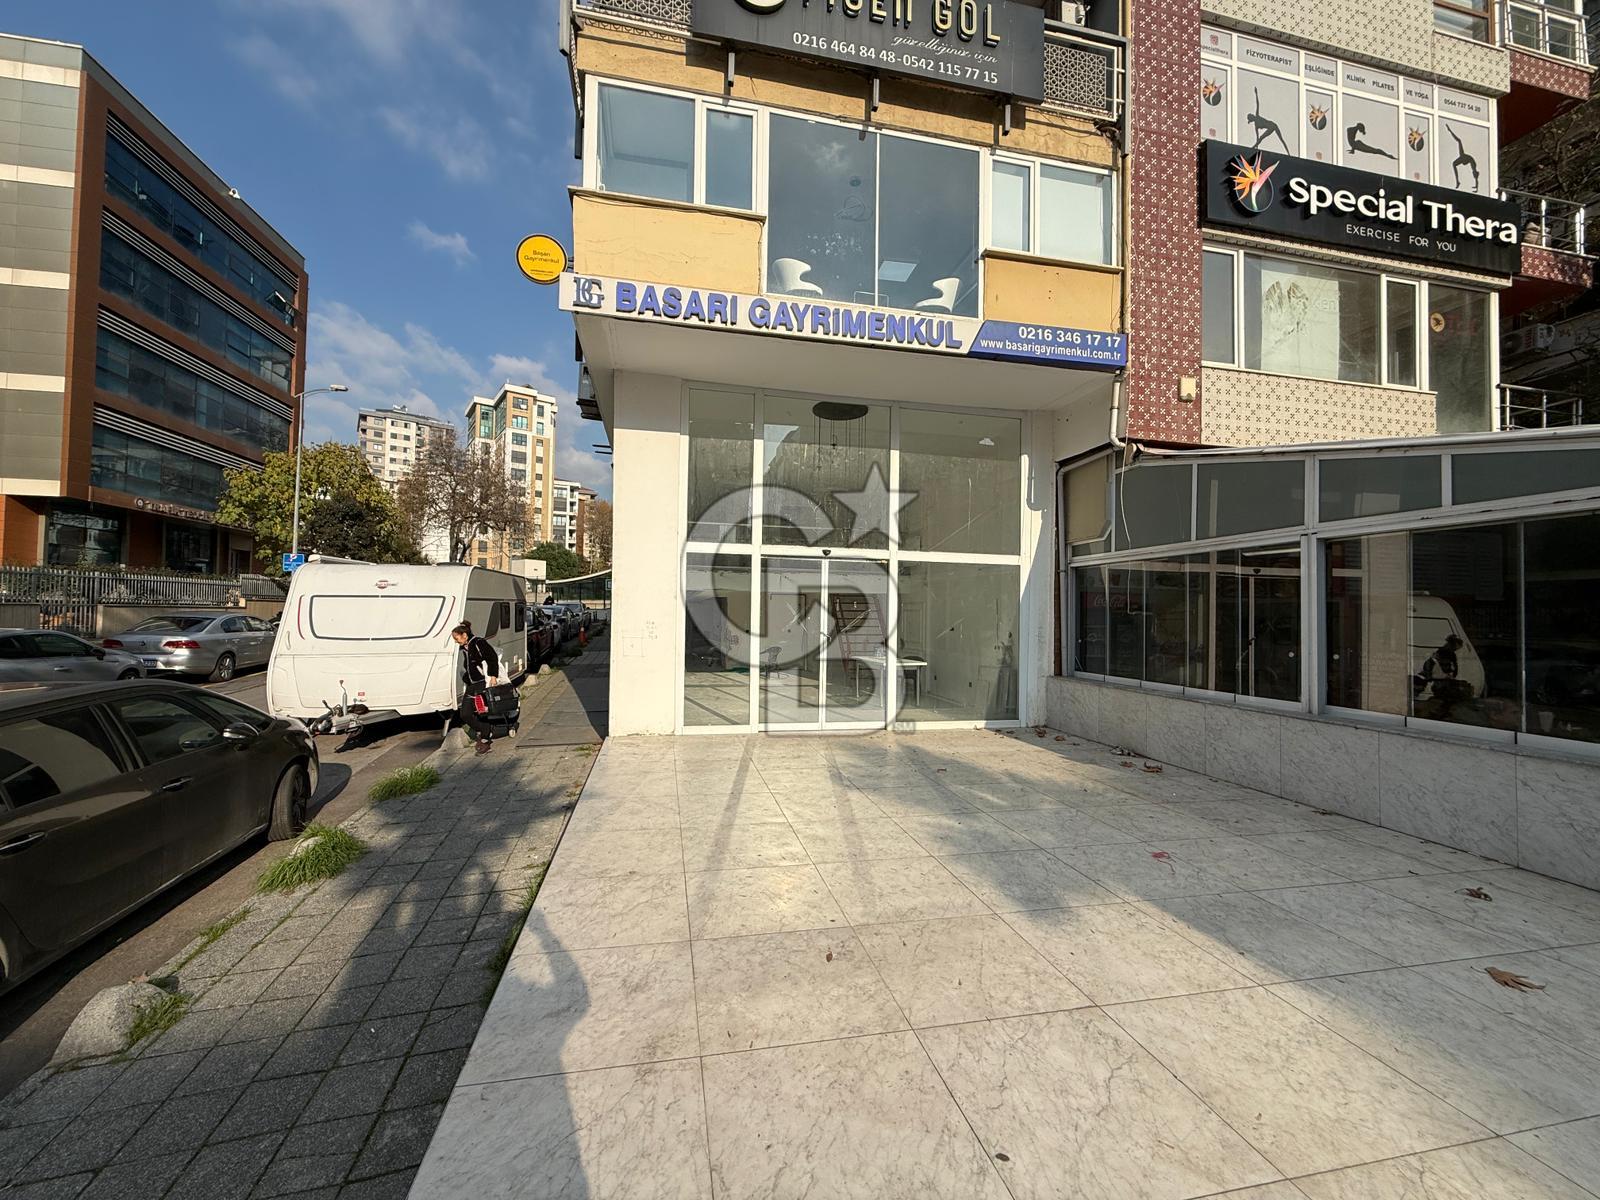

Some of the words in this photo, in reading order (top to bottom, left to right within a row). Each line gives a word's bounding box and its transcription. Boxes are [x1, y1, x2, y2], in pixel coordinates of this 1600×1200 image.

[793, 32, 828, 50] 0216
[830, 40, 856, 55] 464
[859, 45, 876, 60] 84
[879, 49, 935, 71] 48-0542
[938, 61, 961, 77] 115
[964, 66, 980, 80] 77
[983, 70, 998, 84] 15
[1414, 91, 1429, 100] YOGA
[1288, 177, 1414, 225] Special
[1421, 199, 1518, 245] Thera
[1345, 223, 1401, 243] EXERCISE
[1408, 235, 1430, 248] FOR
[1435, 239, 1457, 253] YOU
[1018, 326, 1053, 342] 0216
[1056, 330, 1082, 344] 346
[1085, 333, 1101, 346] 17
[1105, 336, 1121, 348] 17
